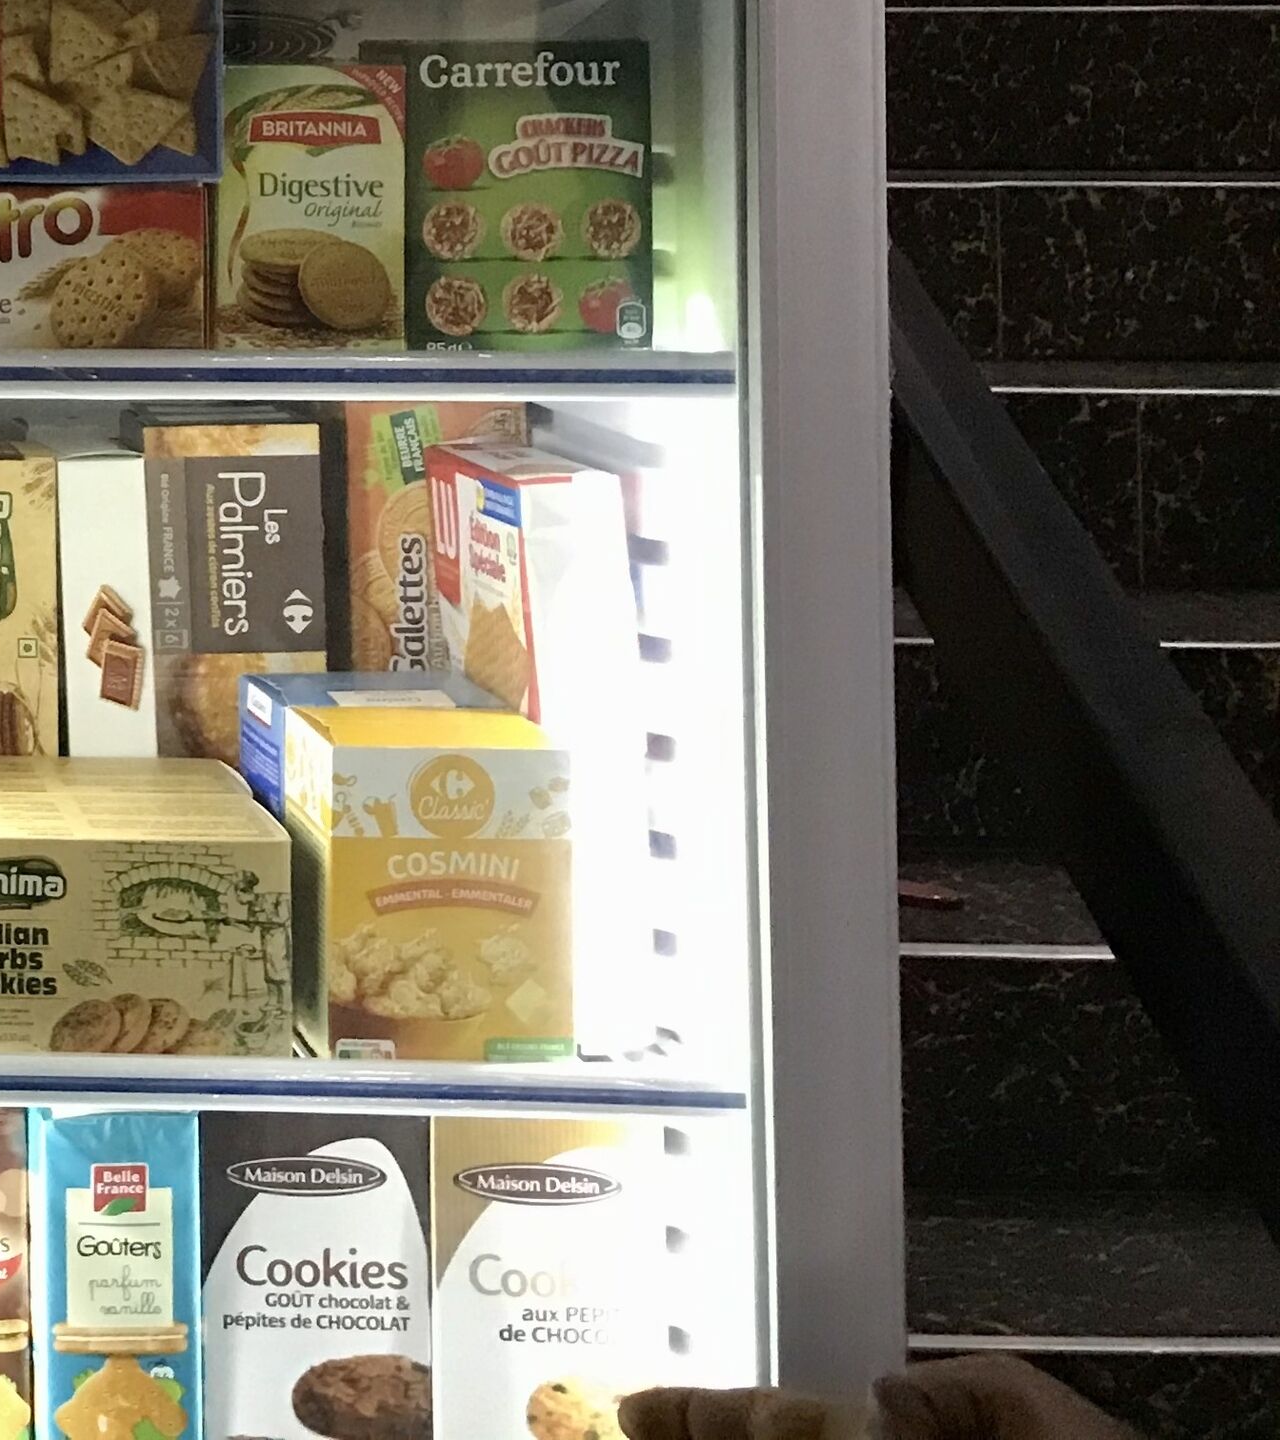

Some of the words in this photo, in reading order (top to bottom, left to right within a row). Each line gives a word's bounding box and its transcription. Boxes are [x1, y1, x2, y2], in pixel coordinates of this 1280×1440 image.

[419, 52, 621, 89] Carrefour
[261, 120, 367, 138] BRITANNIA
[571, 141, 639, 173] PIZZA
[258, 171, 384, 203] Digestive
[303, 200, 383, 228] Original
[263, 509, 288, 545] Les
[162, 526, 175, 573] FRANCE
[217, 472, 267, 636] Palmiers
[387, 850, 520, 881] COSMINI
[375, 888, 443, 908] EMMENTAL
[96, 1182, 145, 1195] France
[102, 1170, 140, 1183] Belle
[245, 1166, 306, 1184] Maison
[311, 1168, 364, 1185] Delsin
[477, 1173, 541, 1192] Maison
[545, 1175, 600, 1195] Delsin
[76, 1235, 162, 1260] Goûters
[236, 1244, 409, 1290] Cookies
[468, 1253, 578, 1297] Cook
[88, 1264, 162, 1301] parfum
[265, 1290, 315, 1309] GOÛT
[318, 1294, 391, 1311] chocolat
[396, 1295, 411, 1311] &
[222, 1311, 286, 1330] pépites
[291, 1313, 313, 1329] de
[316, 1314, 411, 1332] CHOCOLAT
[522, 1308, 560, 1322] aux
[499, 1324, 526, 1342] de
[531, 1326, 609, 1345] CHOCO
